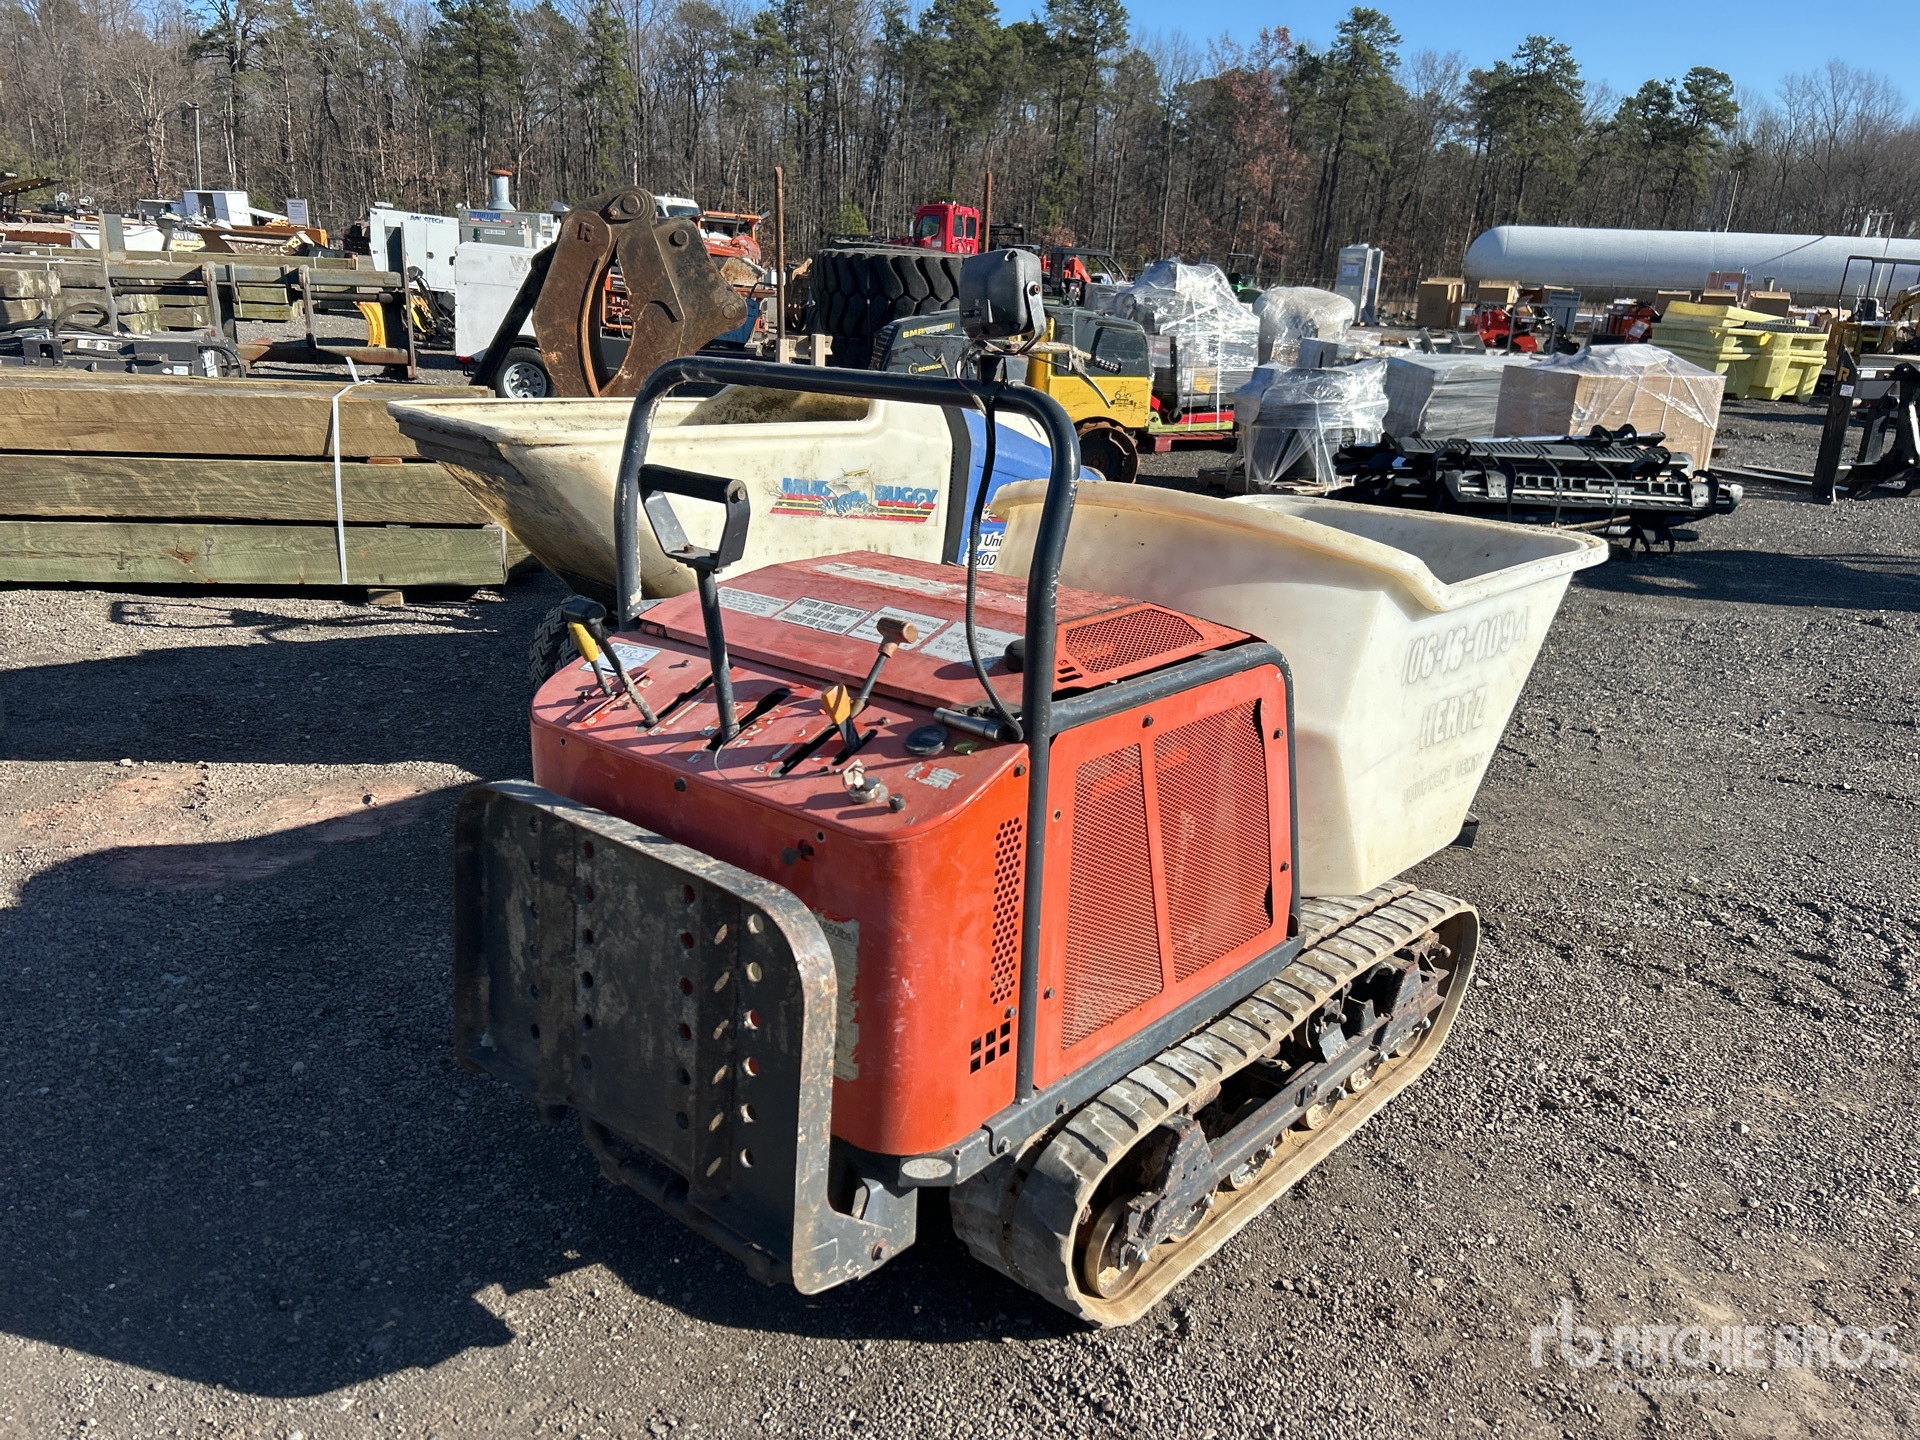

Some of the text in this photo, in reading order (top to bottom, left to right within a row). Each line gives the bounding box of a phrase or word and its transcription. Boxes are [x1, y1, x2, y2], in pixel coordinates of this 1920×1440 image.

[782, 477, 938, 504] MUD BUGGY
[984, 534, 1004, 547] Uni
[1420, 683, 1487, 749] HERTZ
